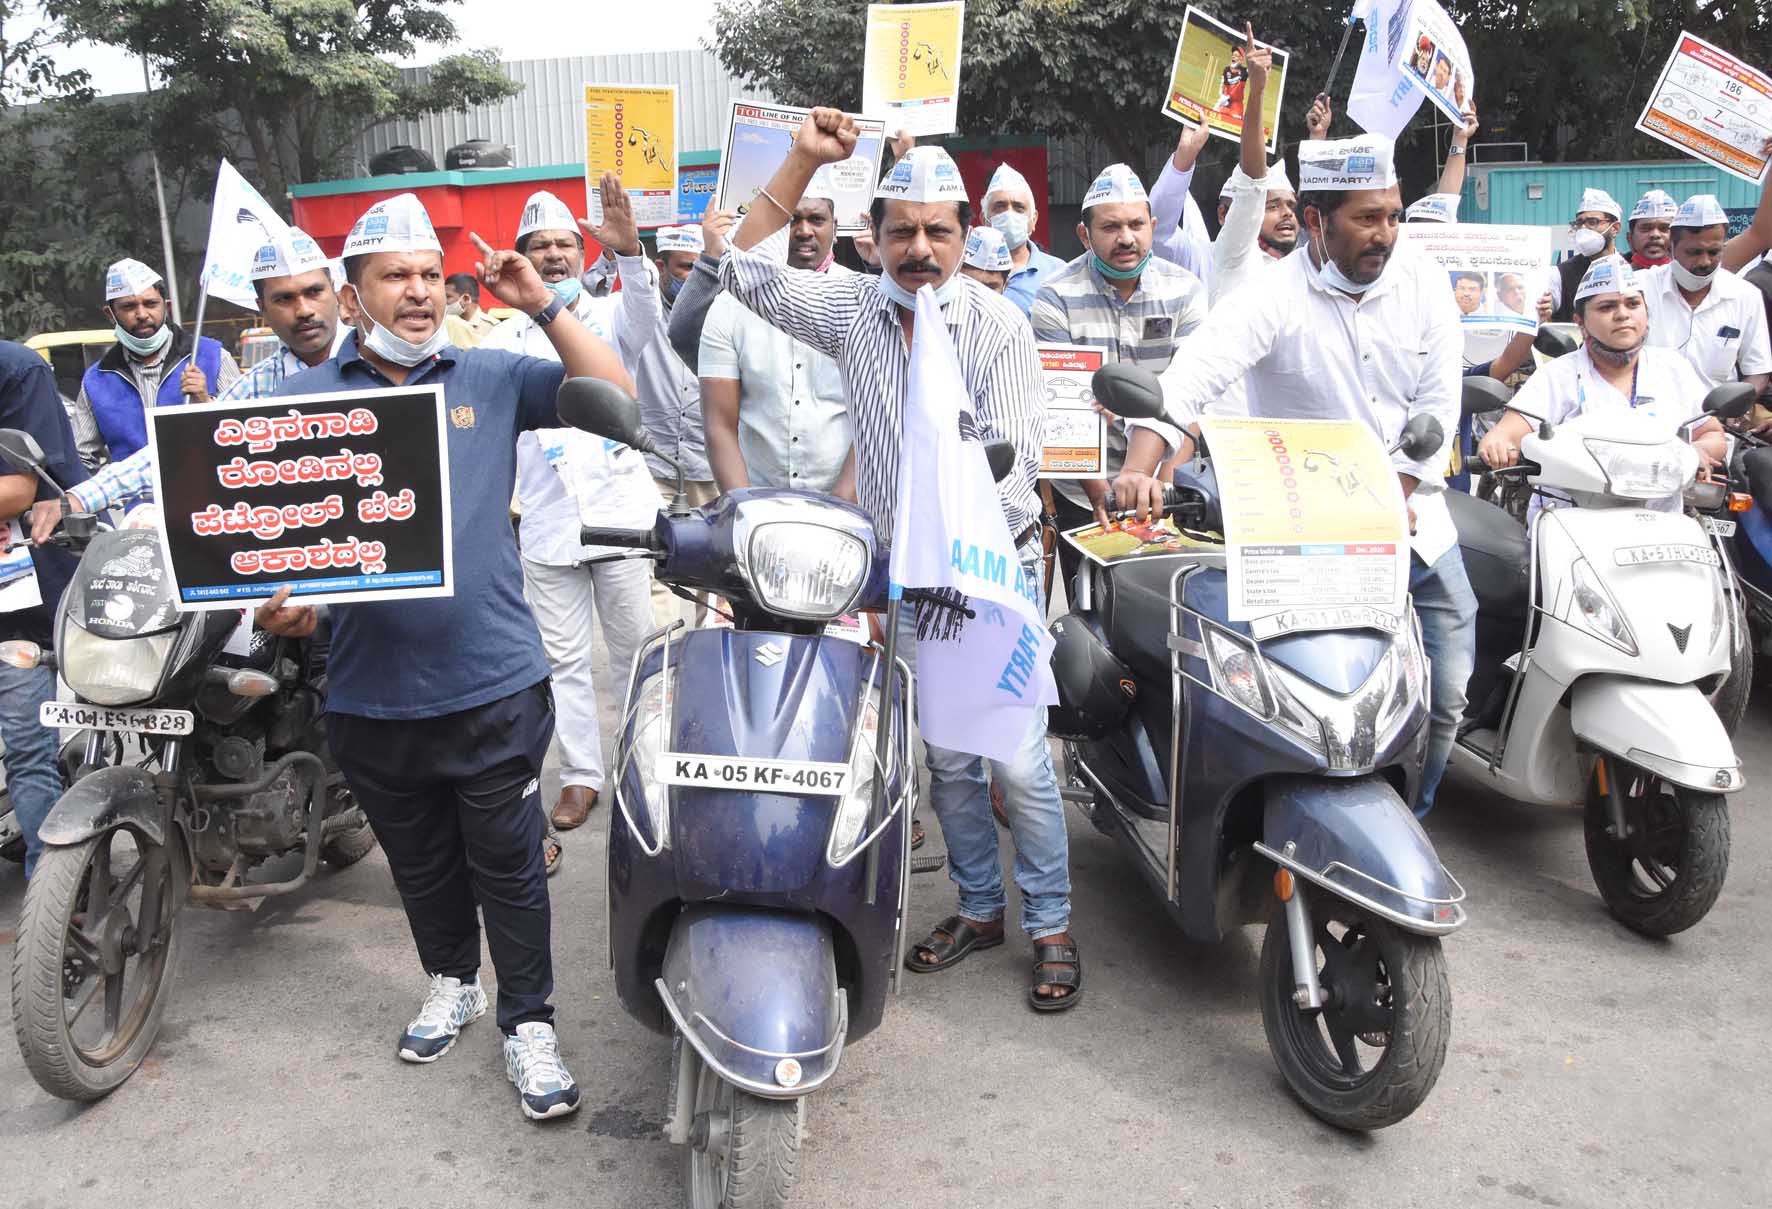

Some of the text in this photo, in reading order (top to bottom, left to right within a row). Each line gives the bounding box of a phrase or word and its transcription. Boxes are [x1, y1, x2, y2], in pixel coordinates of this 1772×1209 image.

[1725, 80, 1743, 96] 186
[739, 107, 760, 118] TOI
[762, 110, 779, 119] LINE
[780, 113, 791, 121] OF
[1713, 109, 1723, 119] 7
[1331, 177, 1373, 185] PARTY
[350, 237, 384, 249] PARTY
[214, 408, 378, 454] ಎತ್ತಿನಗಾಡಿ
[217, 448, 384, 488] ರೋಡಿನಲ್ಲಿ
[191, 488, 417, 540] ಪೆಟ್ರೋಲ್ ಬೆಲೆ
[230, 535, 388, 575] ಆಕಾಶದಲ್ಲಿ
[950, 537, 1009, 587] AAM
[88, 617, 136, 630] HONDA
[675, 760, 846, 789] KA 05 KF 4067
